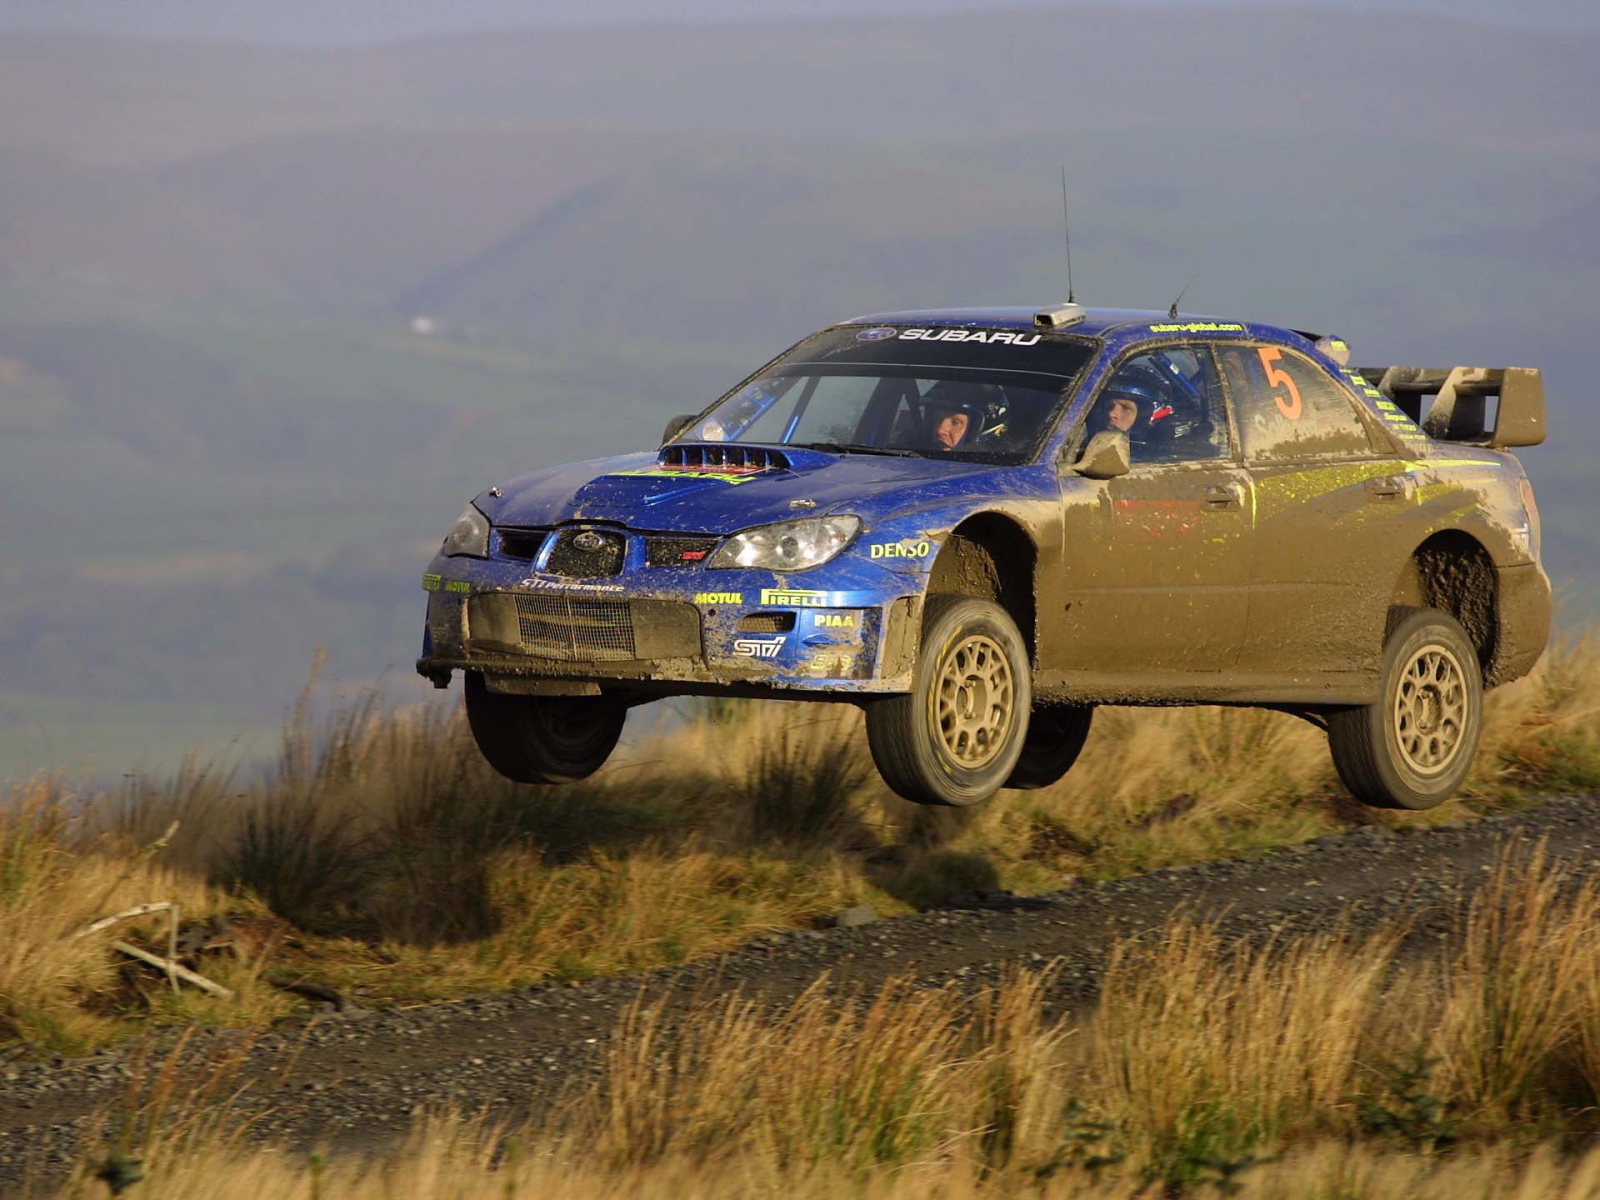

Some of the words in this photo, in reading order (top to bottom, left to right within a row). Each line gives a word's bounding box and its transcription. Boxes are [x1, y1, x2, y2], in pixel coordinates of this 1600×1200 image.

[898, 328, 1042, 346] SUBARU
[1257, 347, 1303, 420] 5
[870, 541, 930, 559] DENSO
[695, 592, 743, 605] MOTUL
[760, 588, 828, 607] PIRELLI
[814, 614, 854, 627] PIAA
